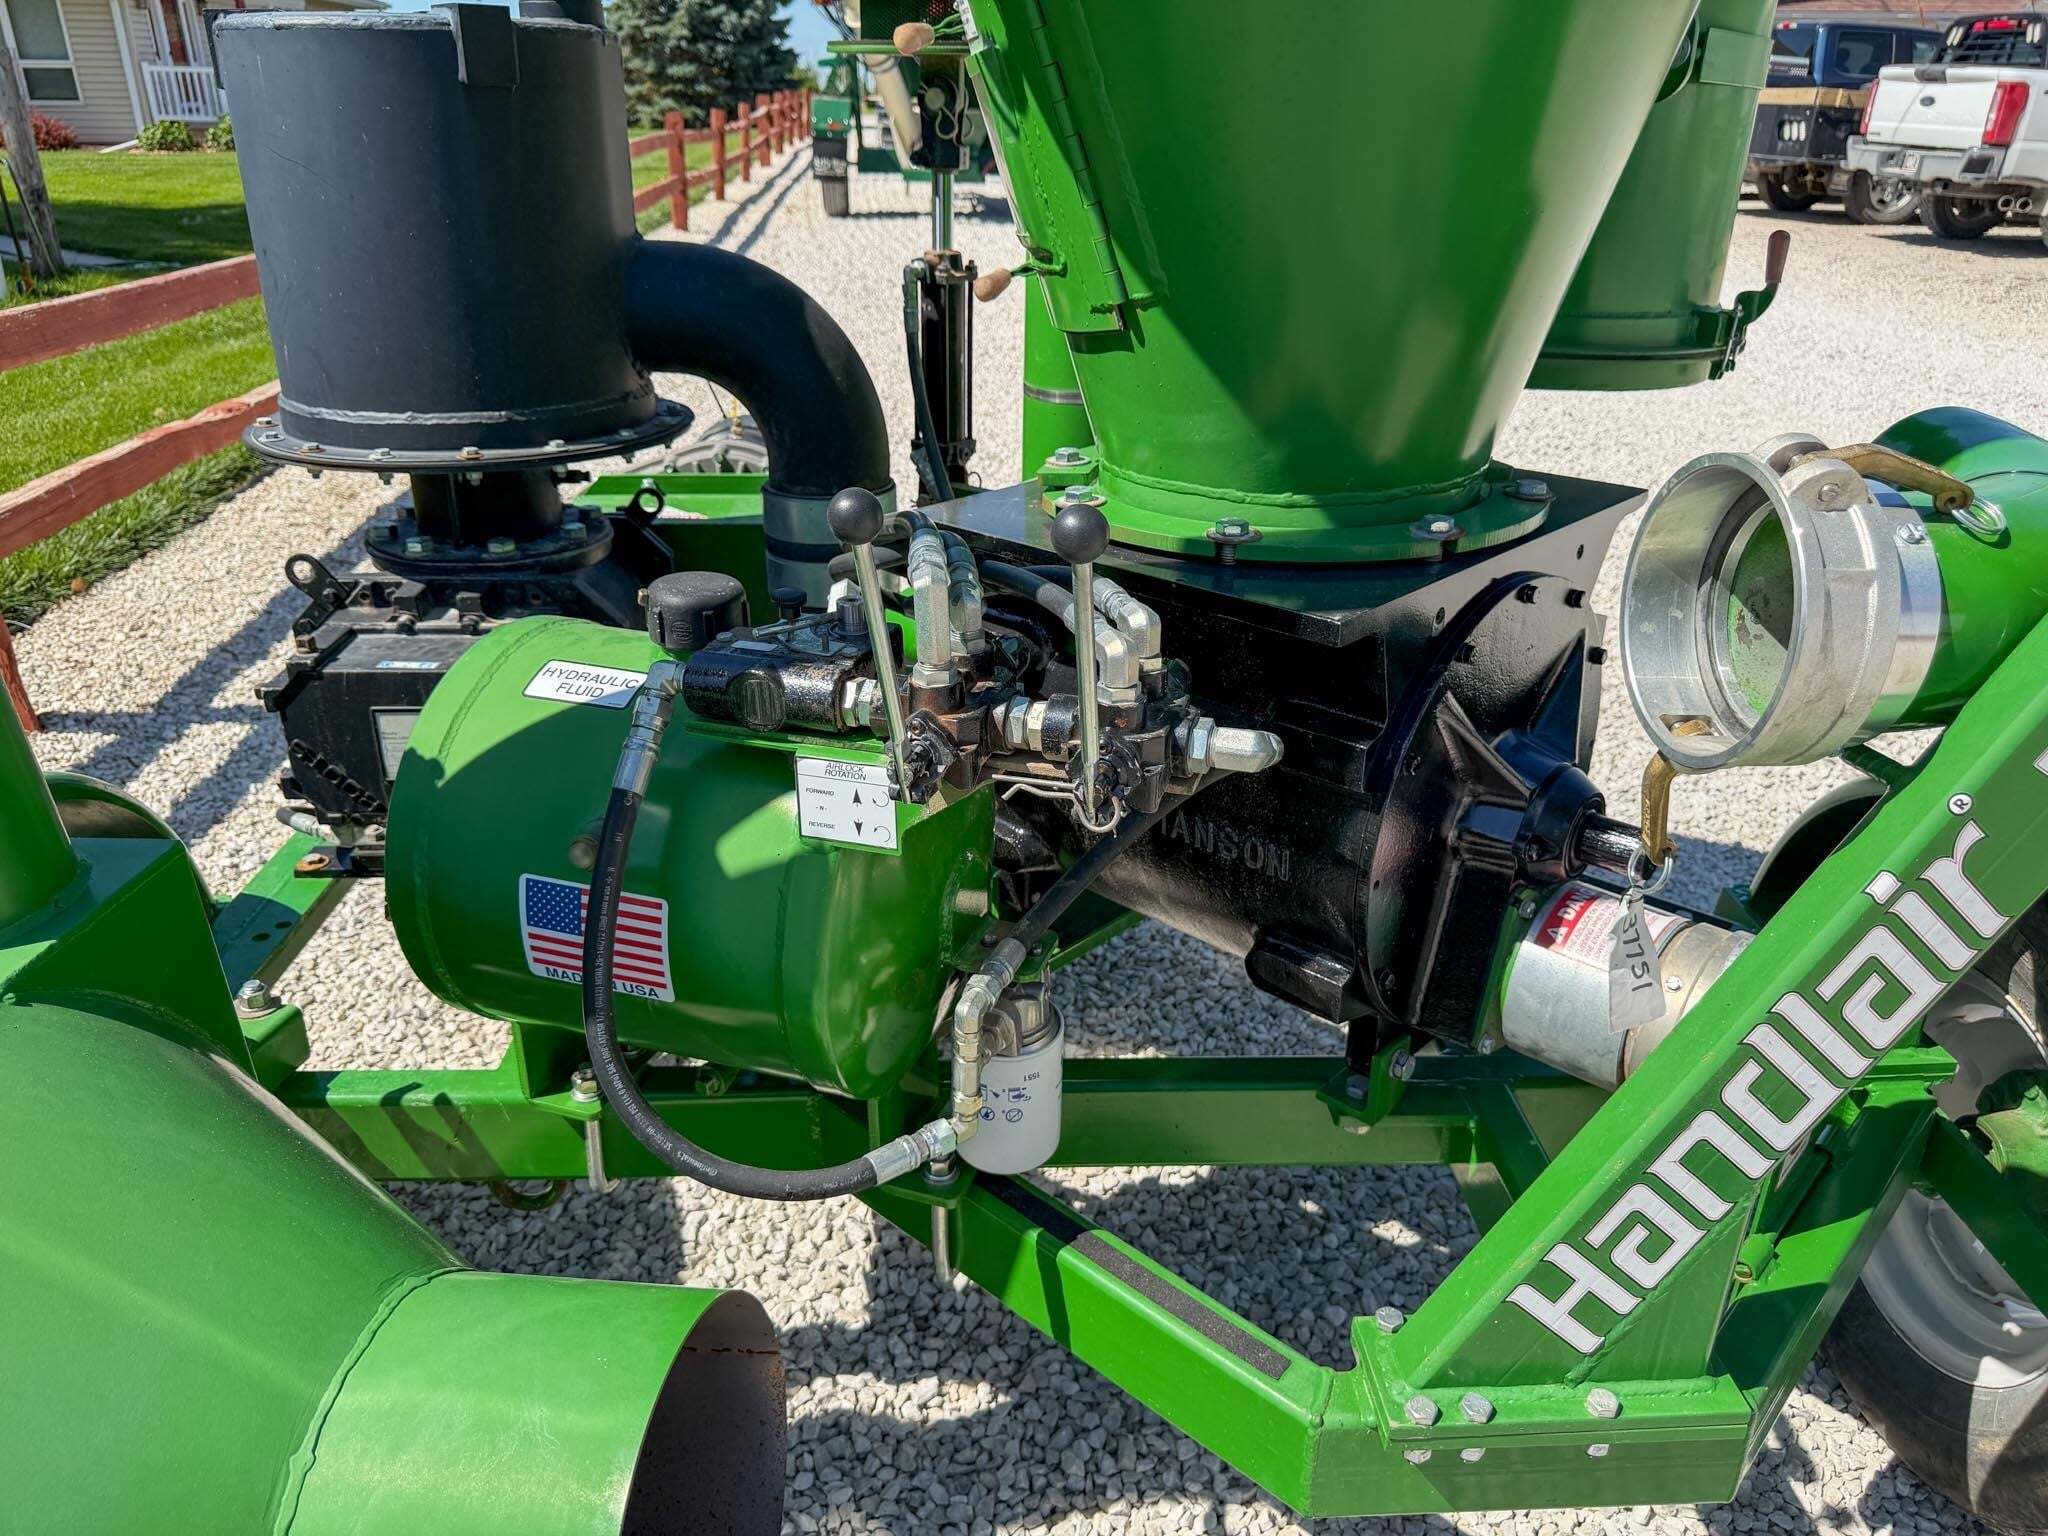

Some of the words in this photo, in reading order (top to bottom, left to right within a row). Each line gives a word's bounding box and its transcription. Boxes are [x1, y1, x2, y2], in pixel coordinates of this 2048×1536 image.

[542, 667, 639, 689] HYDRAULIC
[556, 682, 604, 698] FLUID
[824, 769, 867, 781] ROTATION
[825, 762, 865, 774] AIRLOCK
[806, 787, 834, 796] FORWARD
[808, 821, 836, 829] REVERSE
[1622, 913, 1653, 992] 37751
[545, 966, 583, 983] MAD
[623, 981, 660, 999] USA
